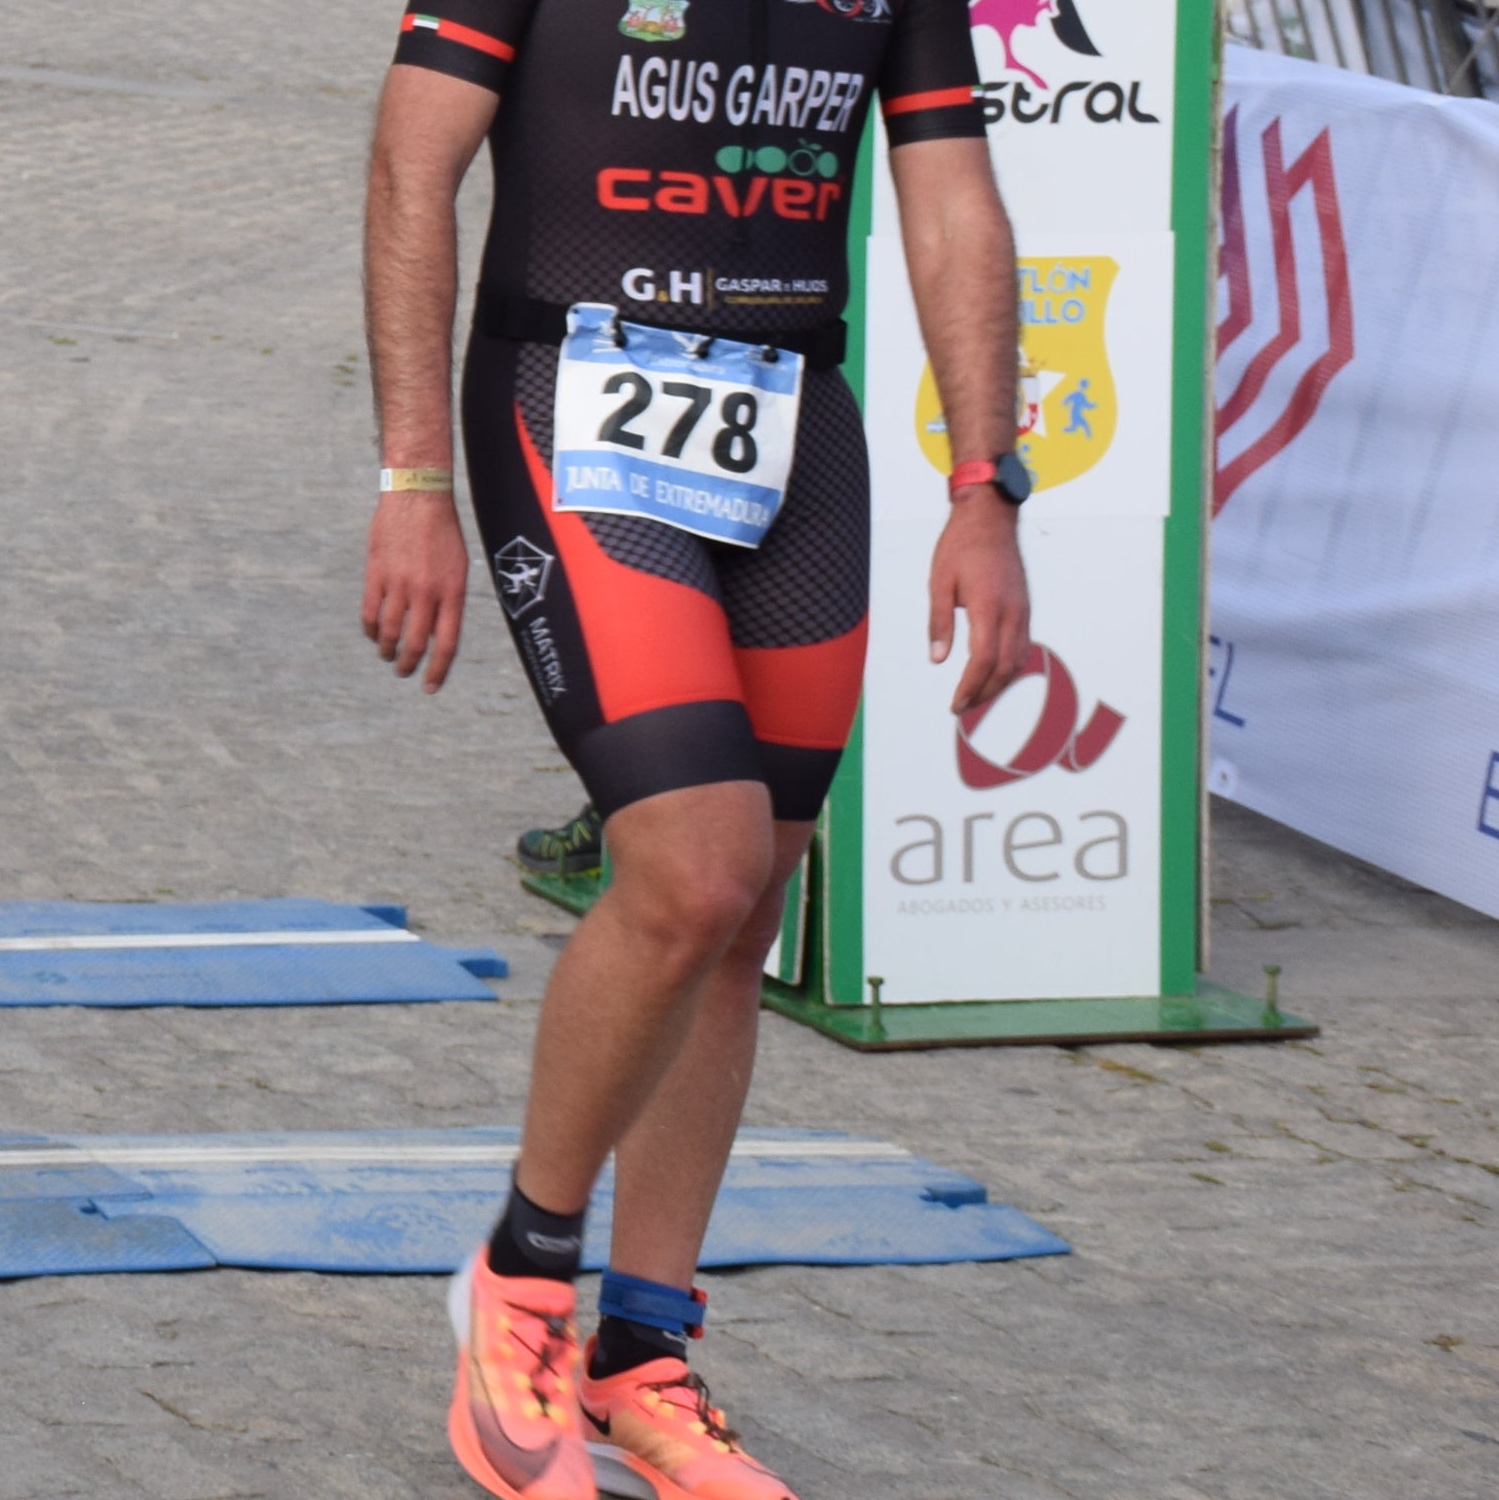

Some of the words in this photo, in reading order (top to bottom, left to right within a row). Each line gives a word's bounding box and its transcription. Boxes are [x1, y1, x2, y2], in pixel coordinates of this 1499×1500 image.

[611, 55, 720, 123] AGUS
[725, 64, 864, 133] GARPER
[982, 80, 1161, 124] stral
[596, 167, 841, 222] caver
[597, 371, 759, 474] 278
[565, 465, 625, 493] JUNTA
[629, 472, 650, 498] DE
[655, 480, 769, 527] EXTREMADURA
[890, 809, 1130, 886] area
[897, 897, 994, 917] ABOGADOS
[1002, 898, 1012, 913] Y
[1021, 894, 1108, 913] ASESORES
